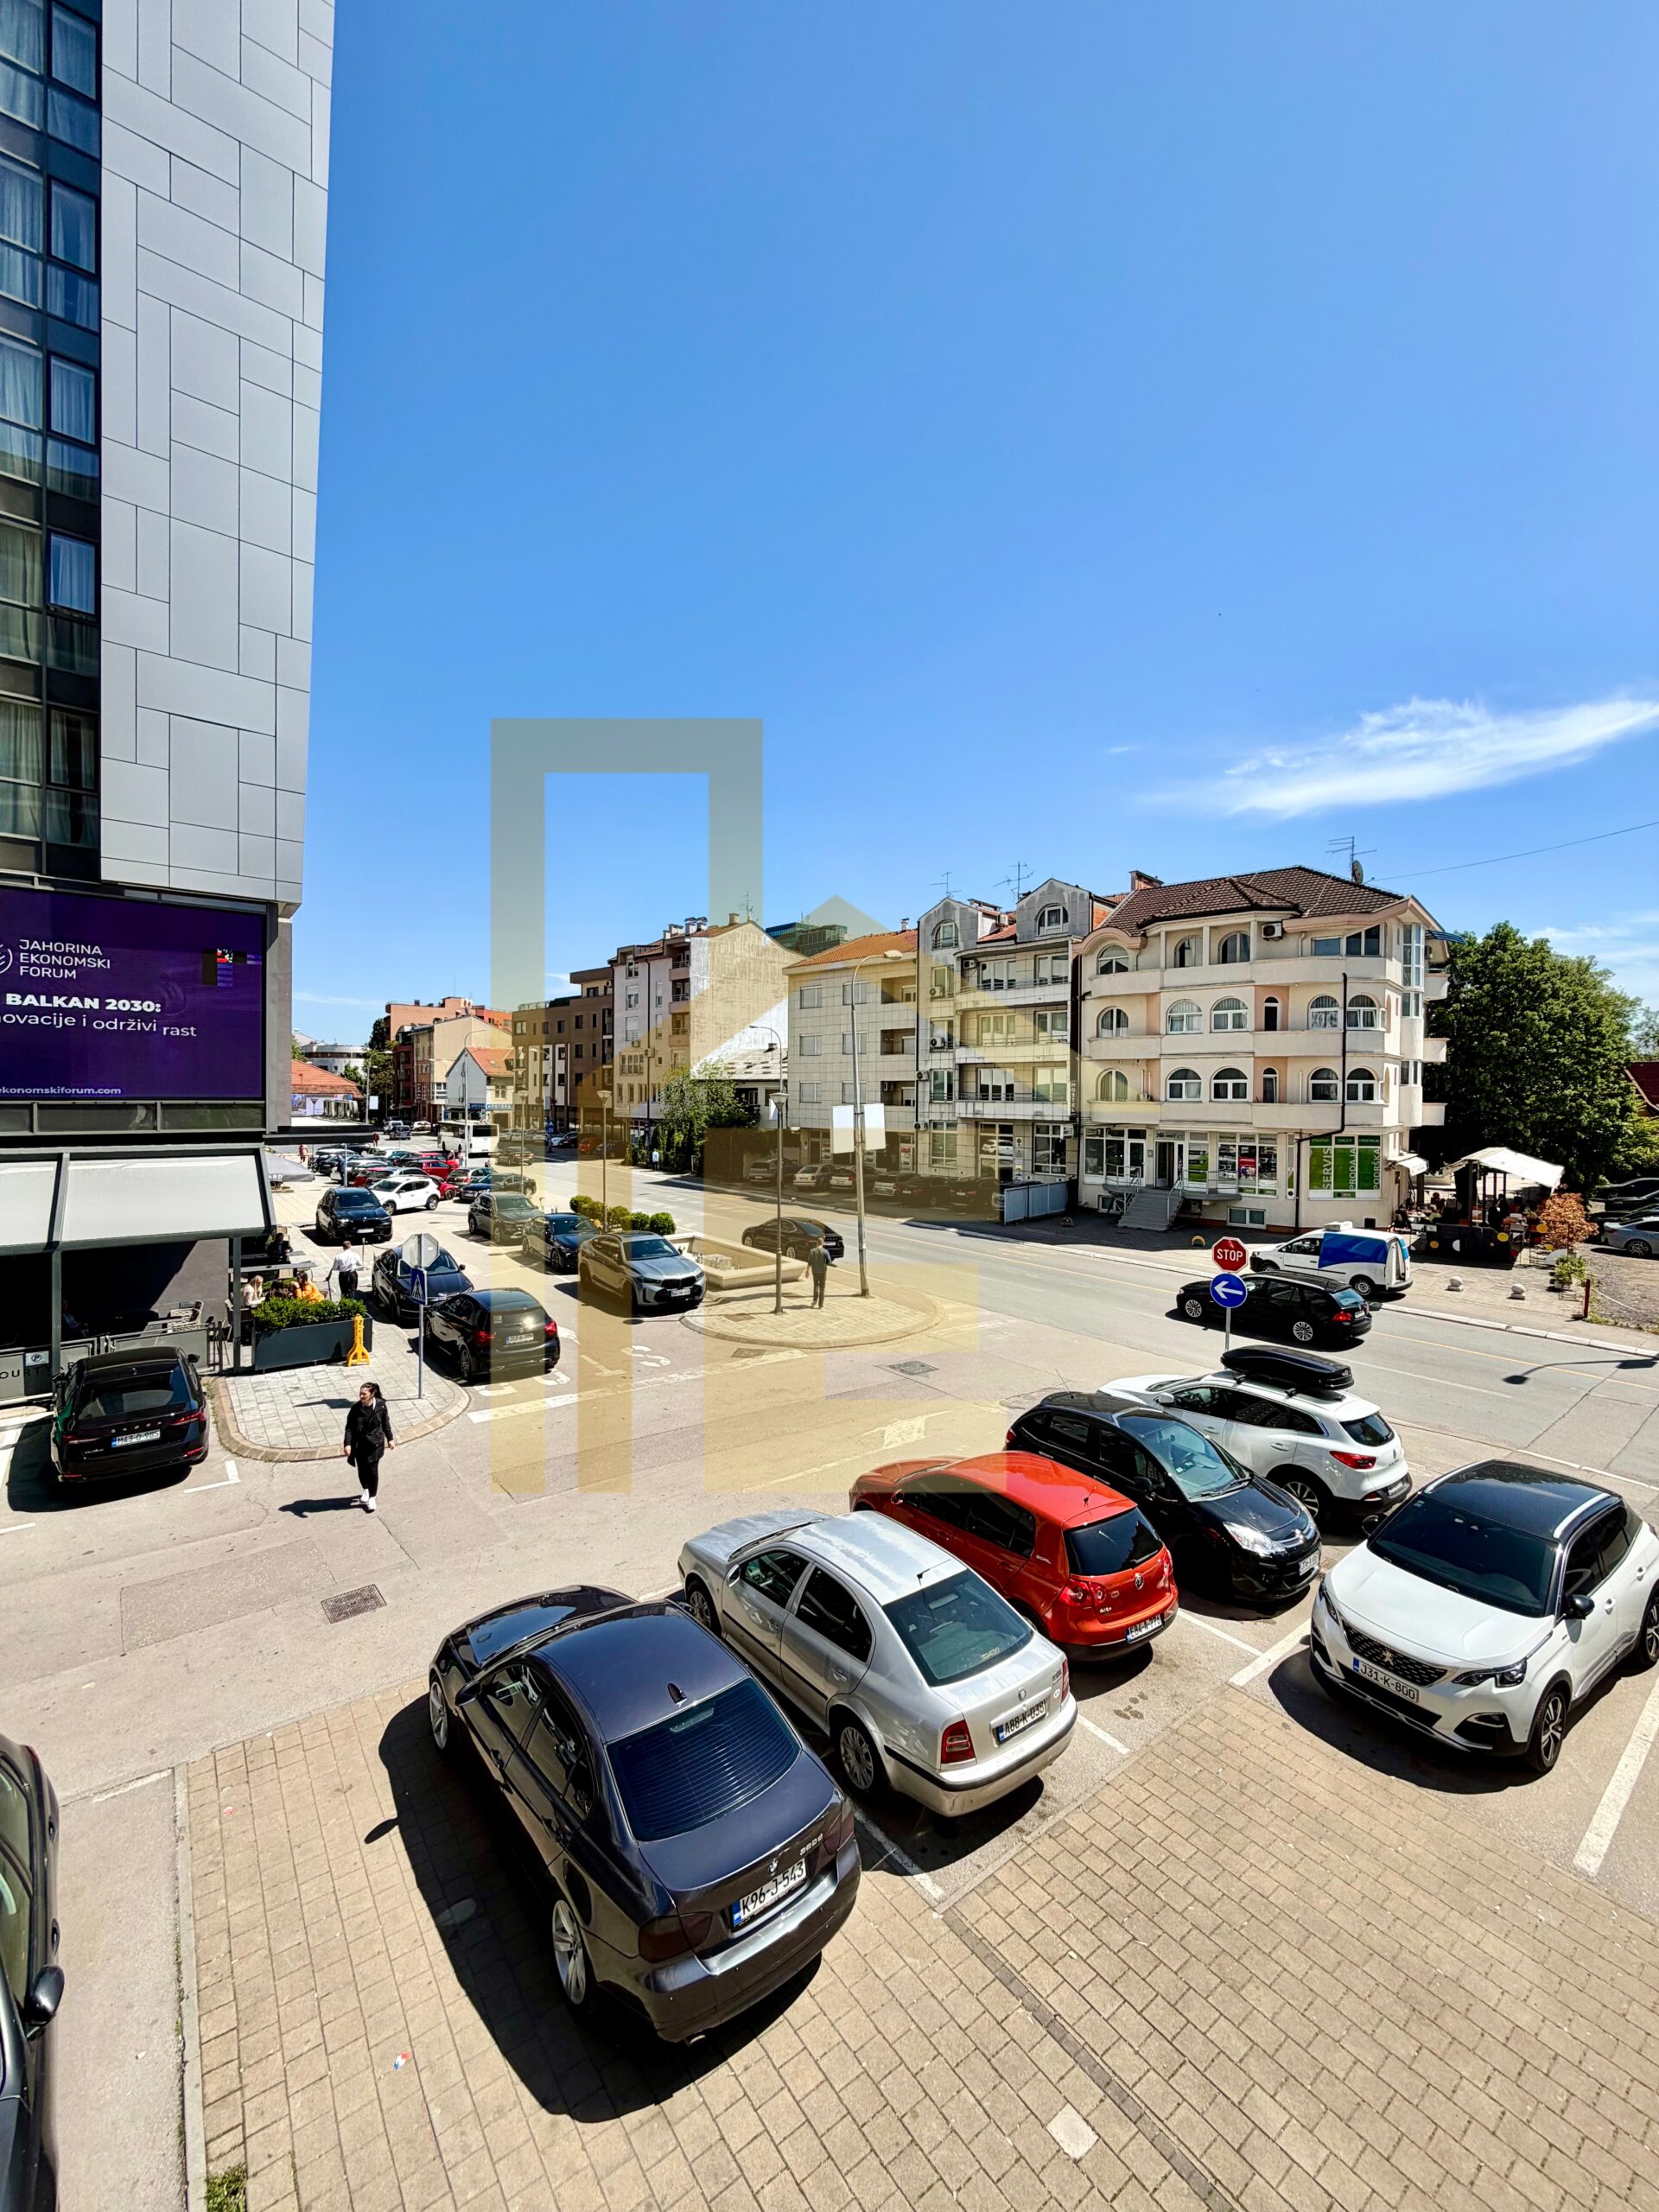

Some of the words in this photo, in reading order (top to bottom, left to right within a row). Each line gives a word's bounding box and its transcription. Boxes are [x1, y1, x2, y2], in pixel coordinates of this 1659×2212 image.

[19, 939, 103, 956] JAHORINA
[20, 953, 111, 969] EKONOMSKI
[20, 966, 77, 979] FORUM
[6, 993, 99, 1009] BALKAN
[105, 998, 162, 1013] 2030:
[82, 1014, 87, 1027] i
[92, 1019, 157, 1032] održivi
[162, 1026, 197, 1037] rast
[1322, 1147, 1332, 1189] SERVIS
[1371, 1148, 1380, 1190] PODRŠKA
[1217, 1249, 1243, 1262] STOP
[1360, 1664, 1415, 1700] J31-K-800
[1005, 1700, 1046, 1736] A88-K-038
[742, 1860, 804, 1916] K96-J-543
